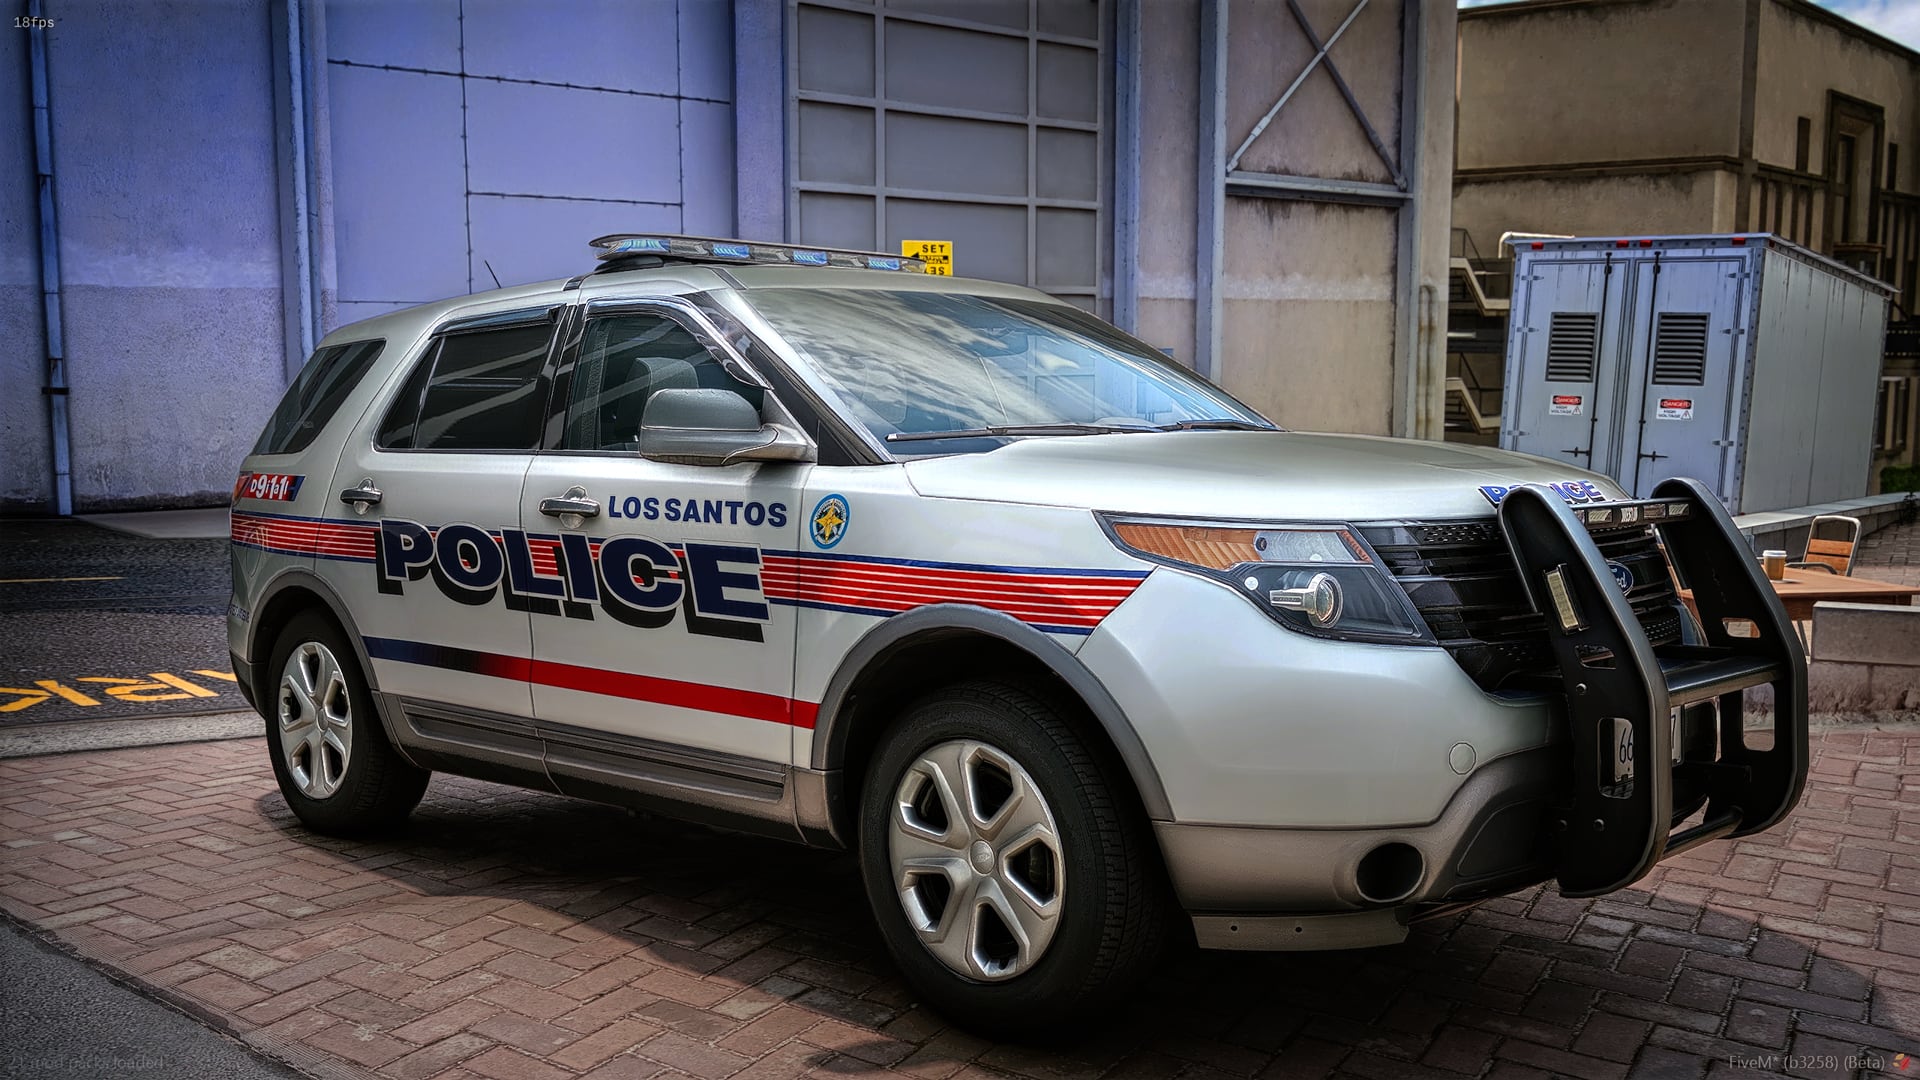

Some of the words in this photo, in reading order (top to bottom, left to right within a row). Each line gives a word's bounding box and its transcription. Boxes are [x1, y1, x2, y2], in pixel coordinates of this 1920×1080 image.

[922, 244, 945, 253] SET
[1662, 400, 1688, 408] DANGER
[1479, 480, 1603, 505] PICE
[608, 495, 660, 521] LOS
[664, 497, 787, 528] SANTOS
[378, 517, 774, 632] POLICE
